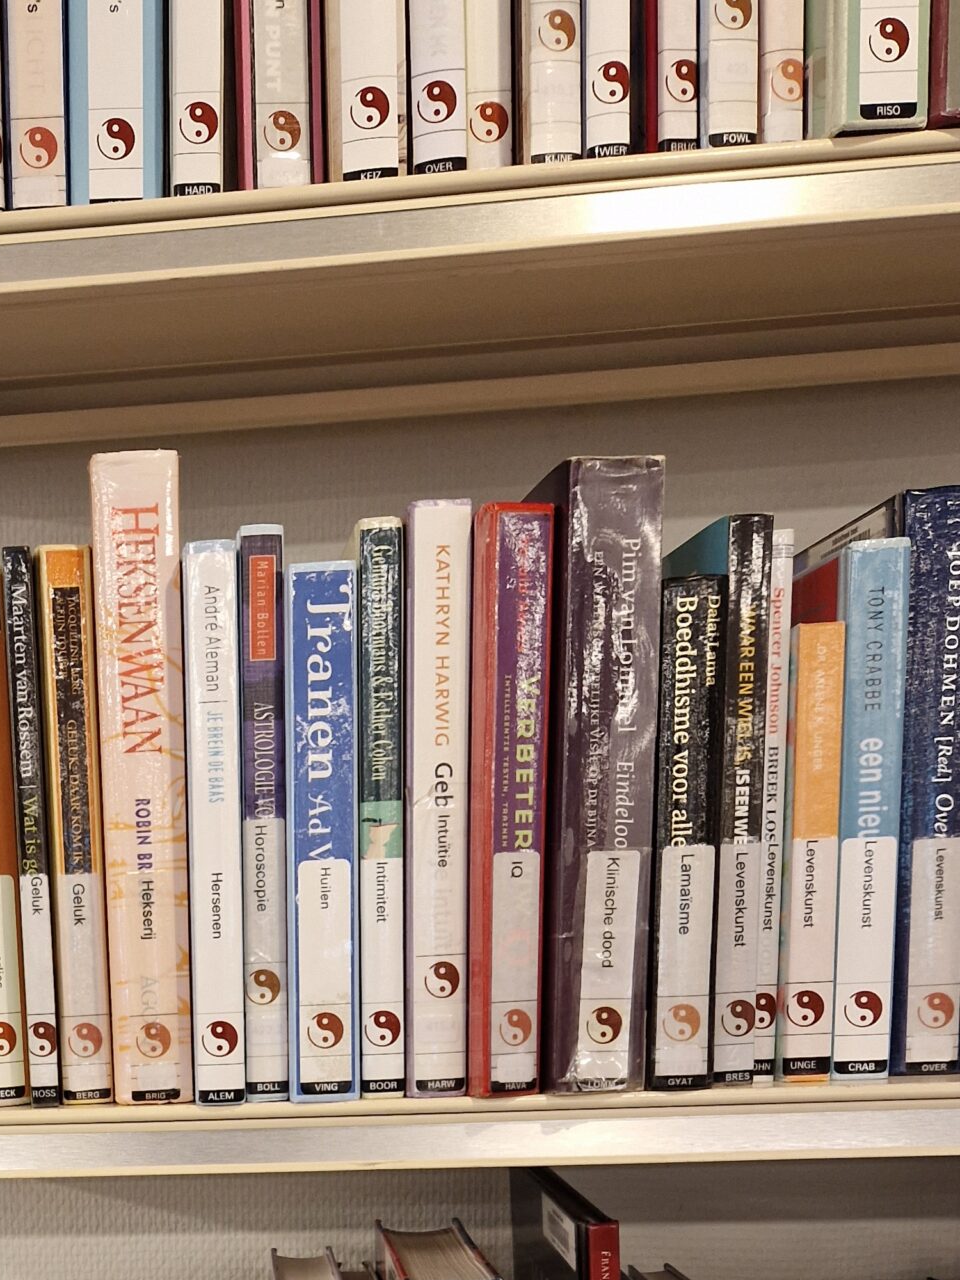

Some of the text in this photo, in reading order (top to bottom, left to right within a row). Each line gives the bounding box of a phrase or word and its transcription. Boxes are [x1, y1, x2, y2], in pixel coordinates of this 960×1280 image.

[876, 104, 901, 117] RISO
[425, 160, 454, 175] OVER
[112, 502, 164, 755] HEKSENWAAN
[205, 585, 223, 692] André Aleman
[435, 545, 450, 747] KATHRYN HARWIG
[865, 586, 884, 711] TONY CRABBE
[10, 583, 31, 779] Maarten van Rossem
[306, 583, 353, 783] Tranen
[254, 825, 266, 913] Horoscopie
[437, 814, 450, 868] Intuïtie
[510, 861, 523, 878] IQ
[804, 840, 818, 928] Levenskunst
[862, 840, 877, 929] Levenskunst
[30, 876, 43, 916] Geluk
[72, 883, 85, 927] Geluk
[141, 879, 156, 940] Hekserij
[211, 872, 223, 939] Hersenen
[320, 867, 331, 910] Huilen
[376, 862, 388, 923] Intimiteit
[602, 857, 620, 968] Klinische dood
[679, 854, 695, 935] Lamaïsme
[734, 852, 748, 948] Levenskunst
[762, 843, 778, 931] Levenskunst
